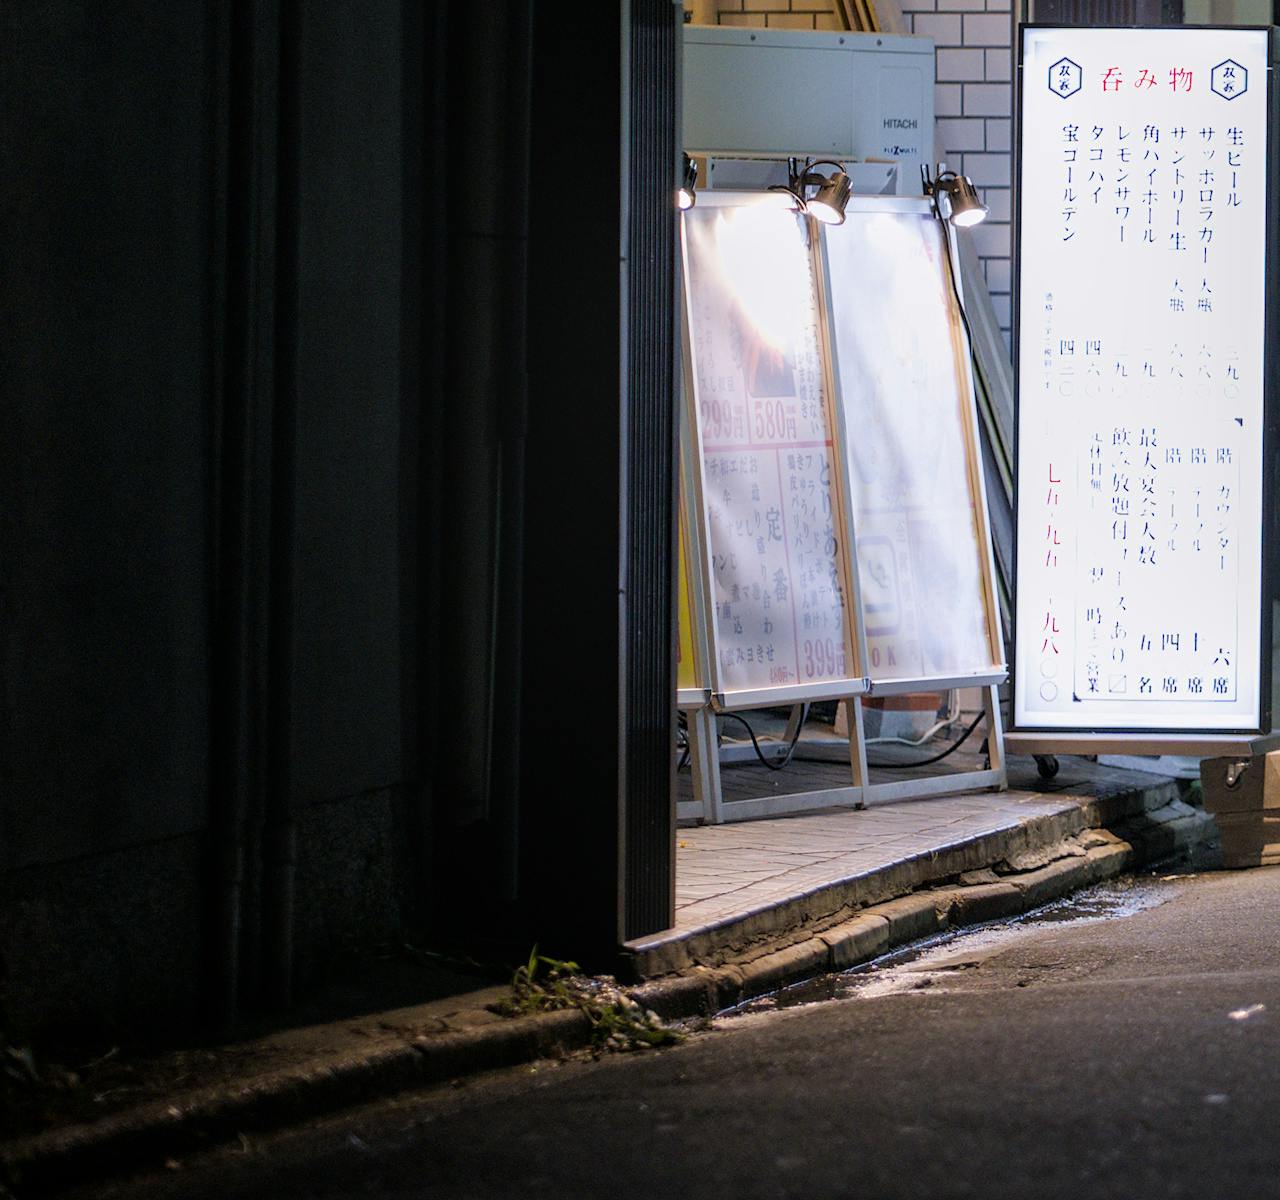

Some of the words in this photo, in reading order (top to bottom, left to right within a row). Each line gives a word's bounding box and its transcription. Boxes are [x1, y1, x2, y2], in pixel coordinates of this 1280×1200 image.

[1098, 65, 1194, 94] 呑み物
[883, 119, 918, 129] HITACHI
[1088, 125, 1104, 204] タコハイ
[1115, 125, 1132, 242] レモンサワー
[1168, 126, 1188, 253] サントリー生
[1224, 126, 1248, 208] 生ビール
[754, 400, 798, 440] 580円
[765, 506, 789, 602] 定番
[804, 639, 847, 678] 399円
